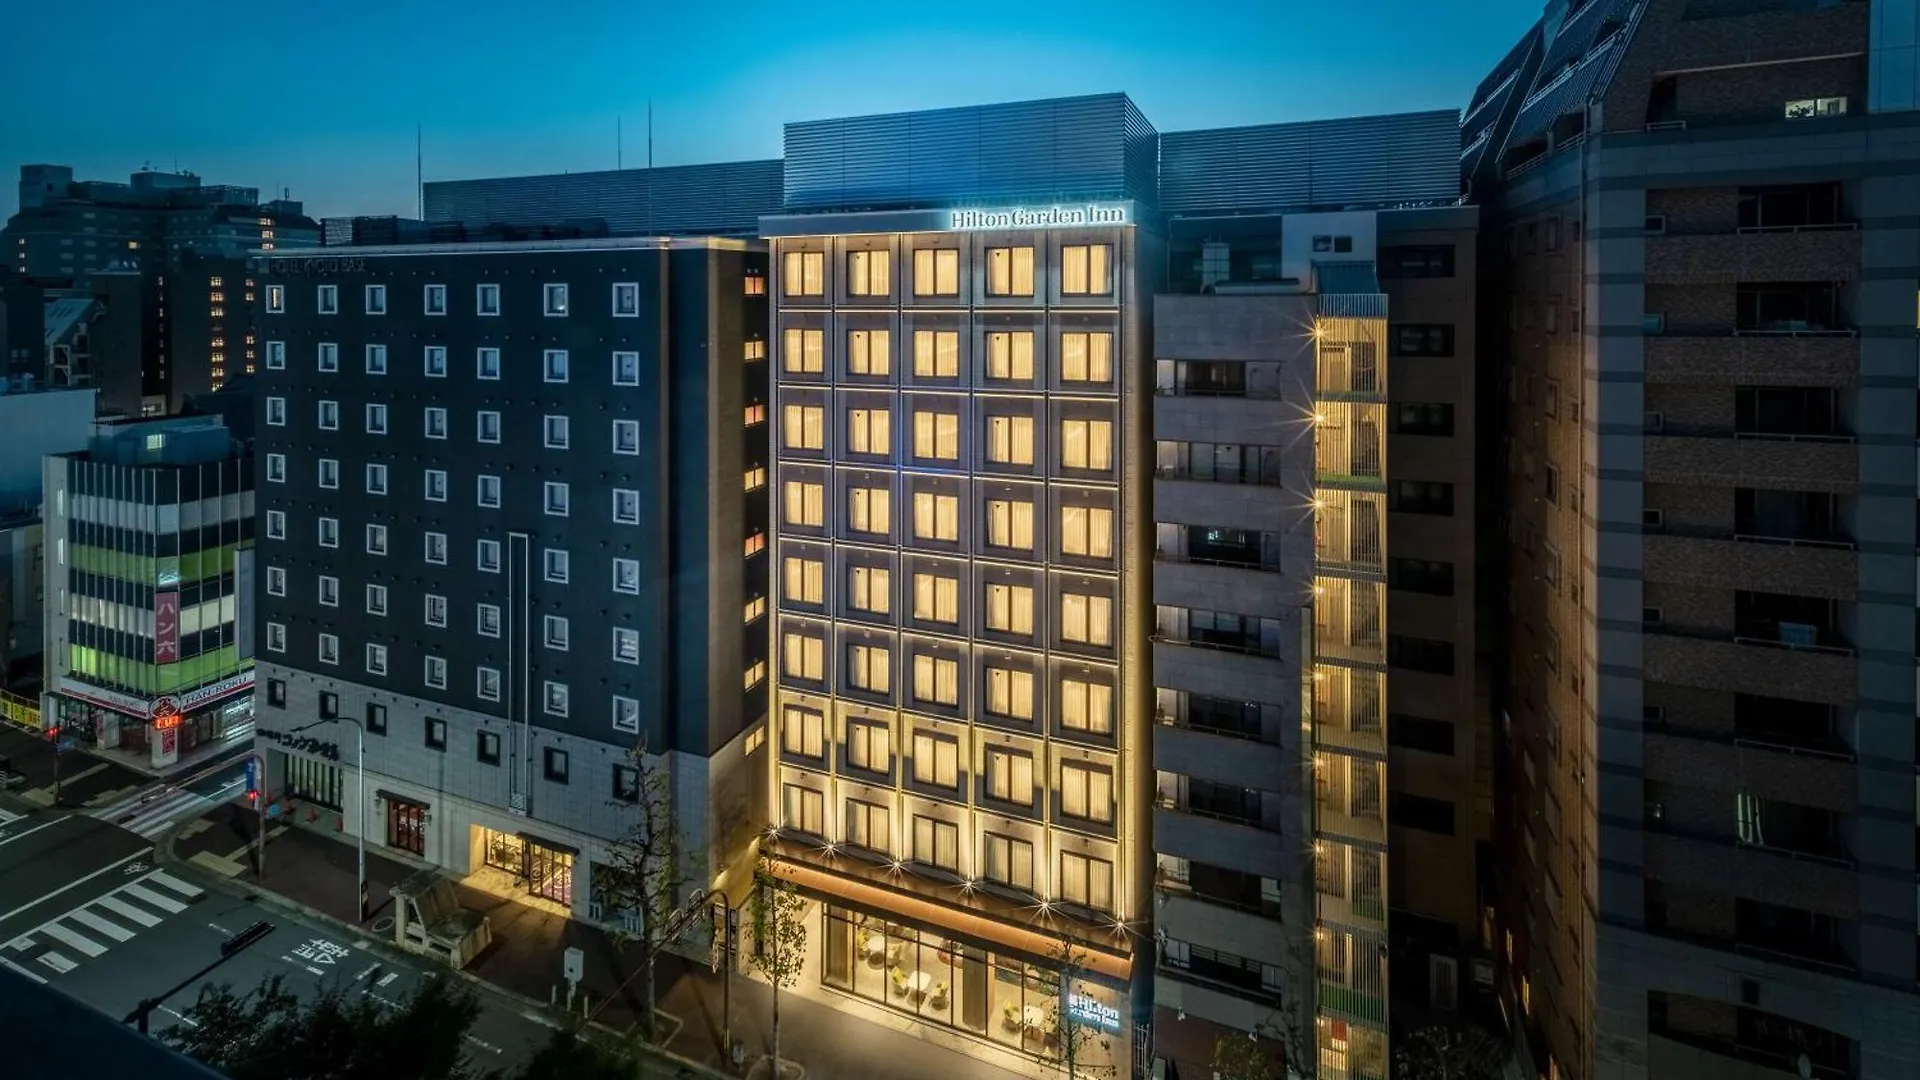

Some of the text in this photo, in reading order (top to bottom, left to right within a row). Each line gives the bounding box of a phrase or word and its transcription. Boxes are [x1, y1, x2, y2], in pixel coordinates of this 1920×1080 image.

[952, 206, 1124, 228] Hilton Garden Inn
[157, 602, 175, 654] ハン六
